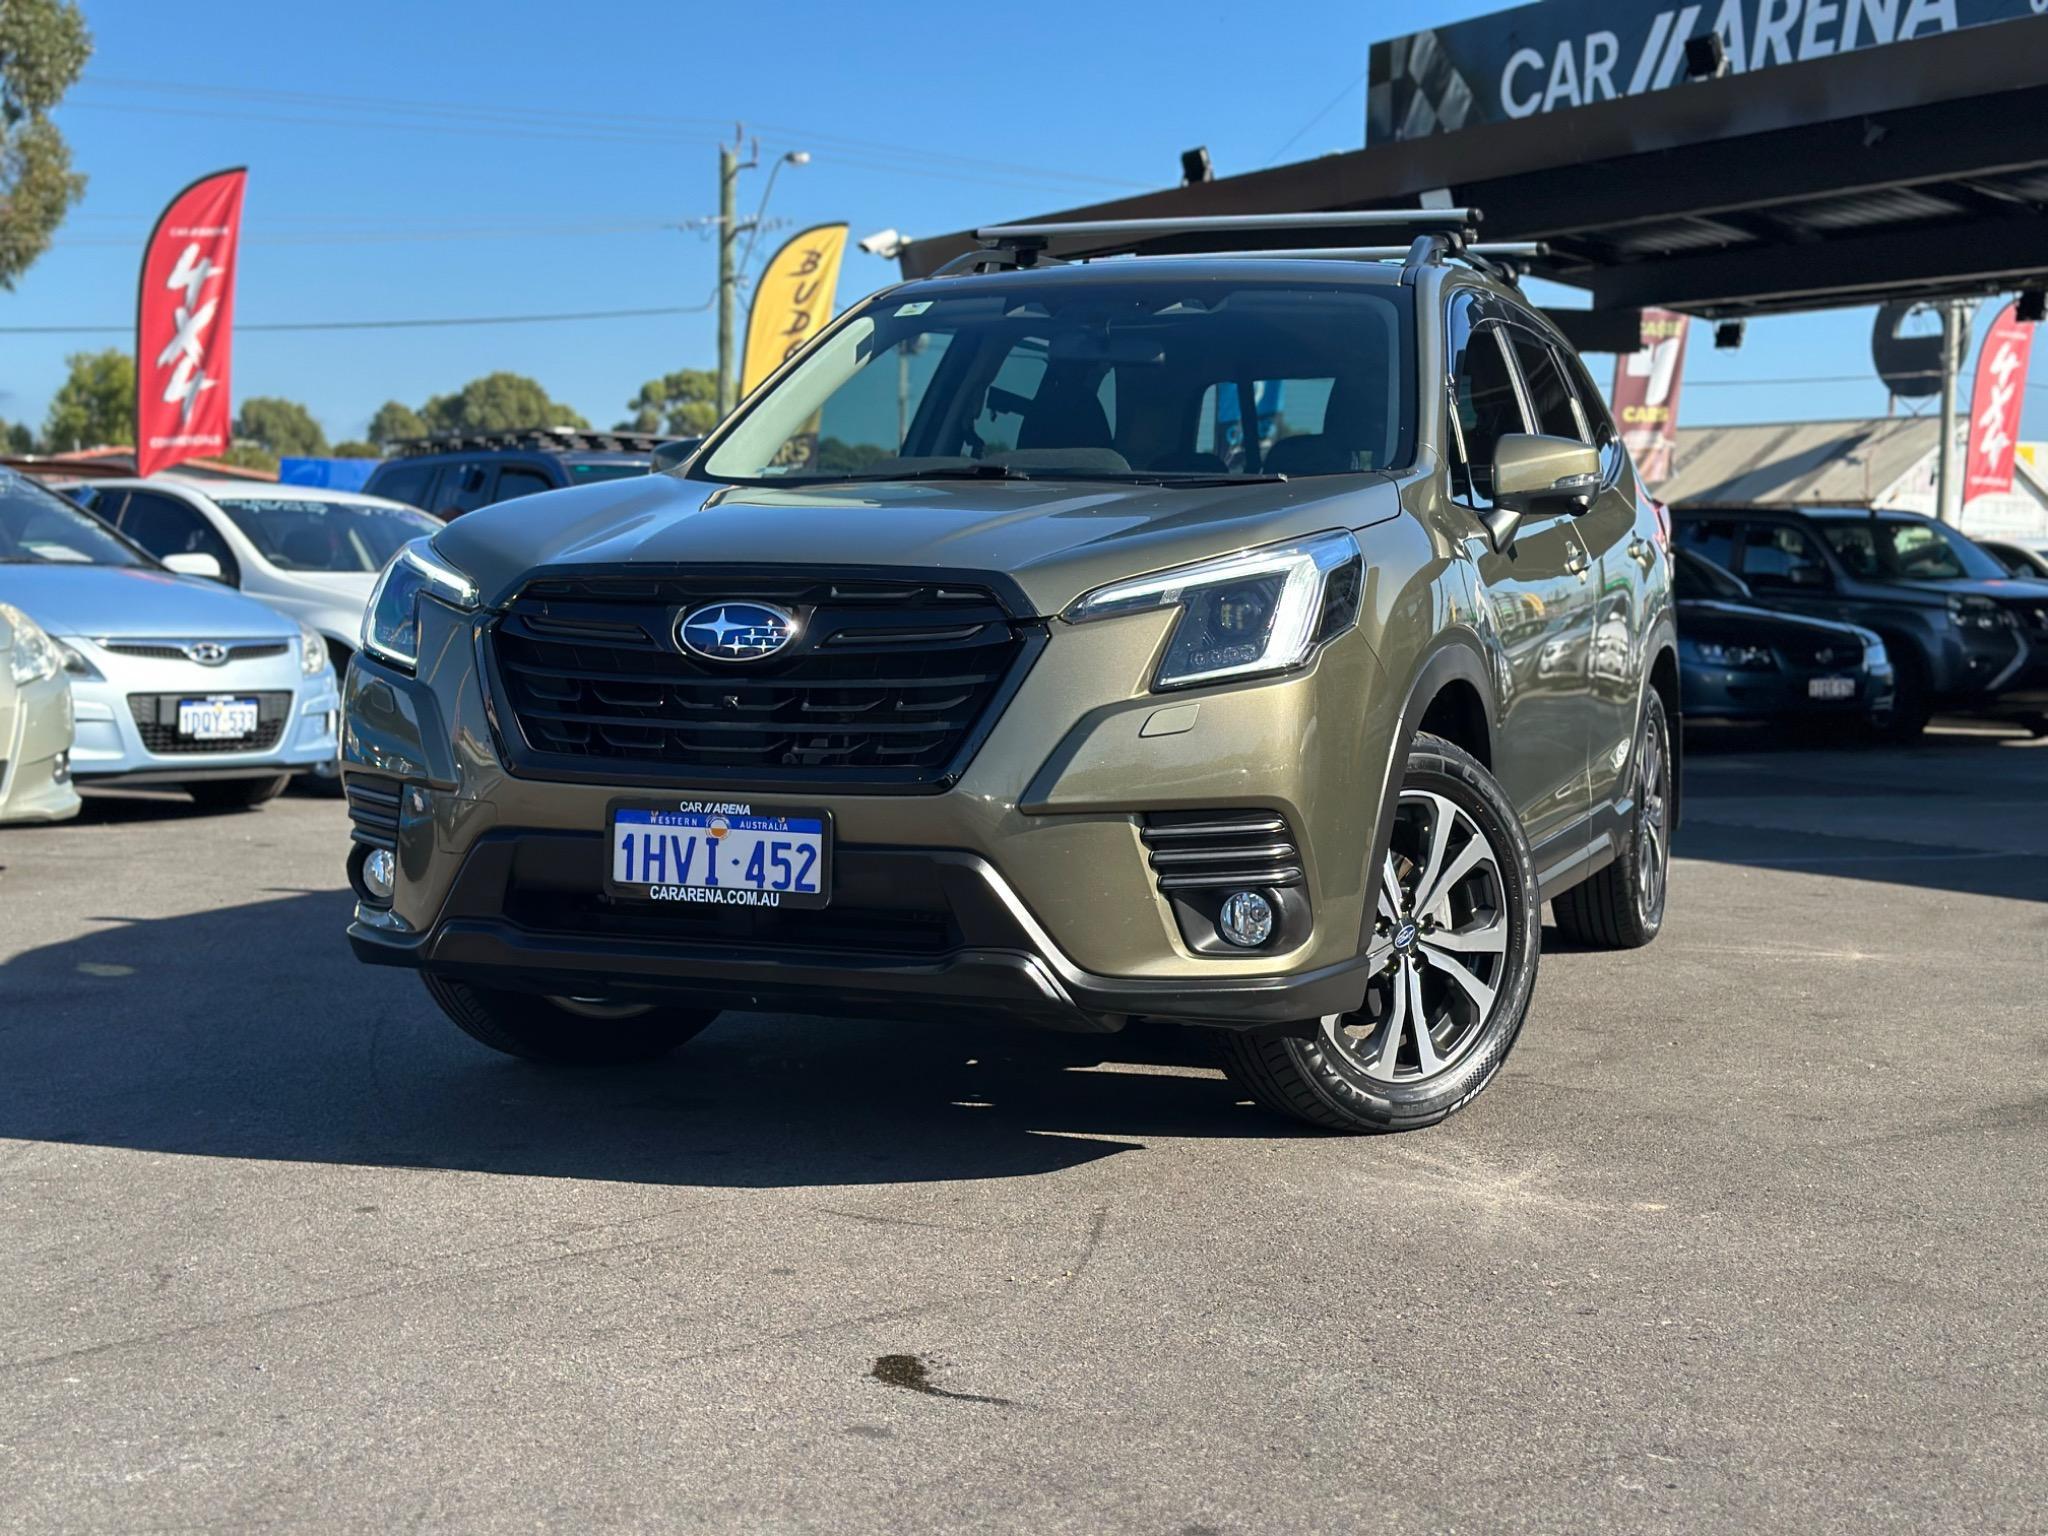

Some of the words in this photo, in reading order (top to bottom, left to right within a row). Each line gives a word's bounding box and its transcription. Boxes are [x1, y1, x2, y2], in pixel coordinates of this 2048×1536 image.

[1502, 30, 1619, 119] CAR
[680, 801, 703, 813] CAR
[651, 816, 698, 827] WESTERN
[740, 820, 788, 831] AUSTRALIA
[650, 885, 780, 907] CARARENA.COM.AU
